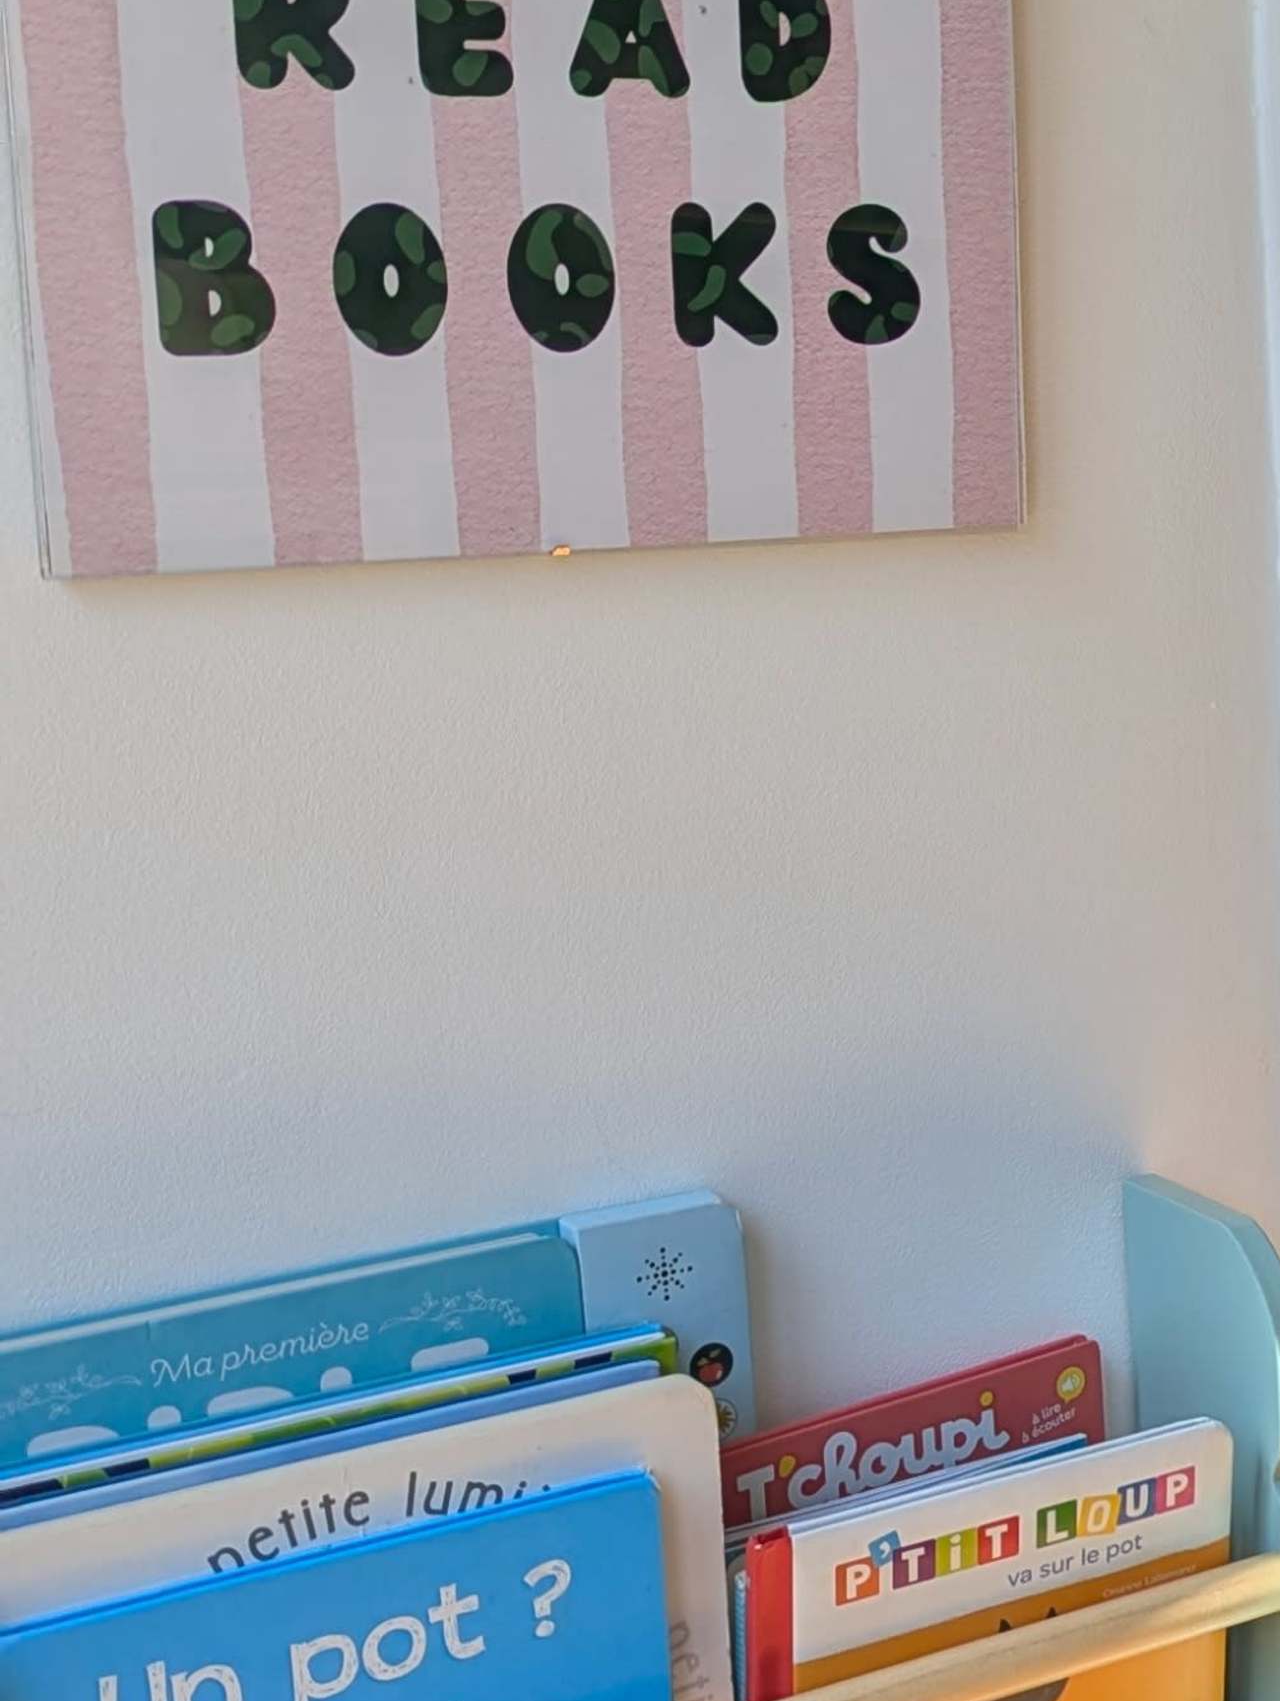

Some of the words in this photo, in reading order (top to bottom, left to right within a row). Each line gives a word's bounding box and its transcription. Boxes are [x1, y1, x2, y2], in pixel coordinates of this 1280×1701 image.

[151, 199, 921, 357] BOOKS
[151, 1353, 213, 1387] Ma
[220, 1321, 369, 1381] première
[736, 1390, 1010, 1518] T'choupi
[1041, 1470, 1193, 1547] LOUP
[523, 1558, 572, 1638] ?
[1008, 1568, 1033, 1588] va
[1039, 1554, 1075, 1579] sur
[1081, 1547, 1100, 1566] le
[1106, 1534, 1143, 1564] pot
